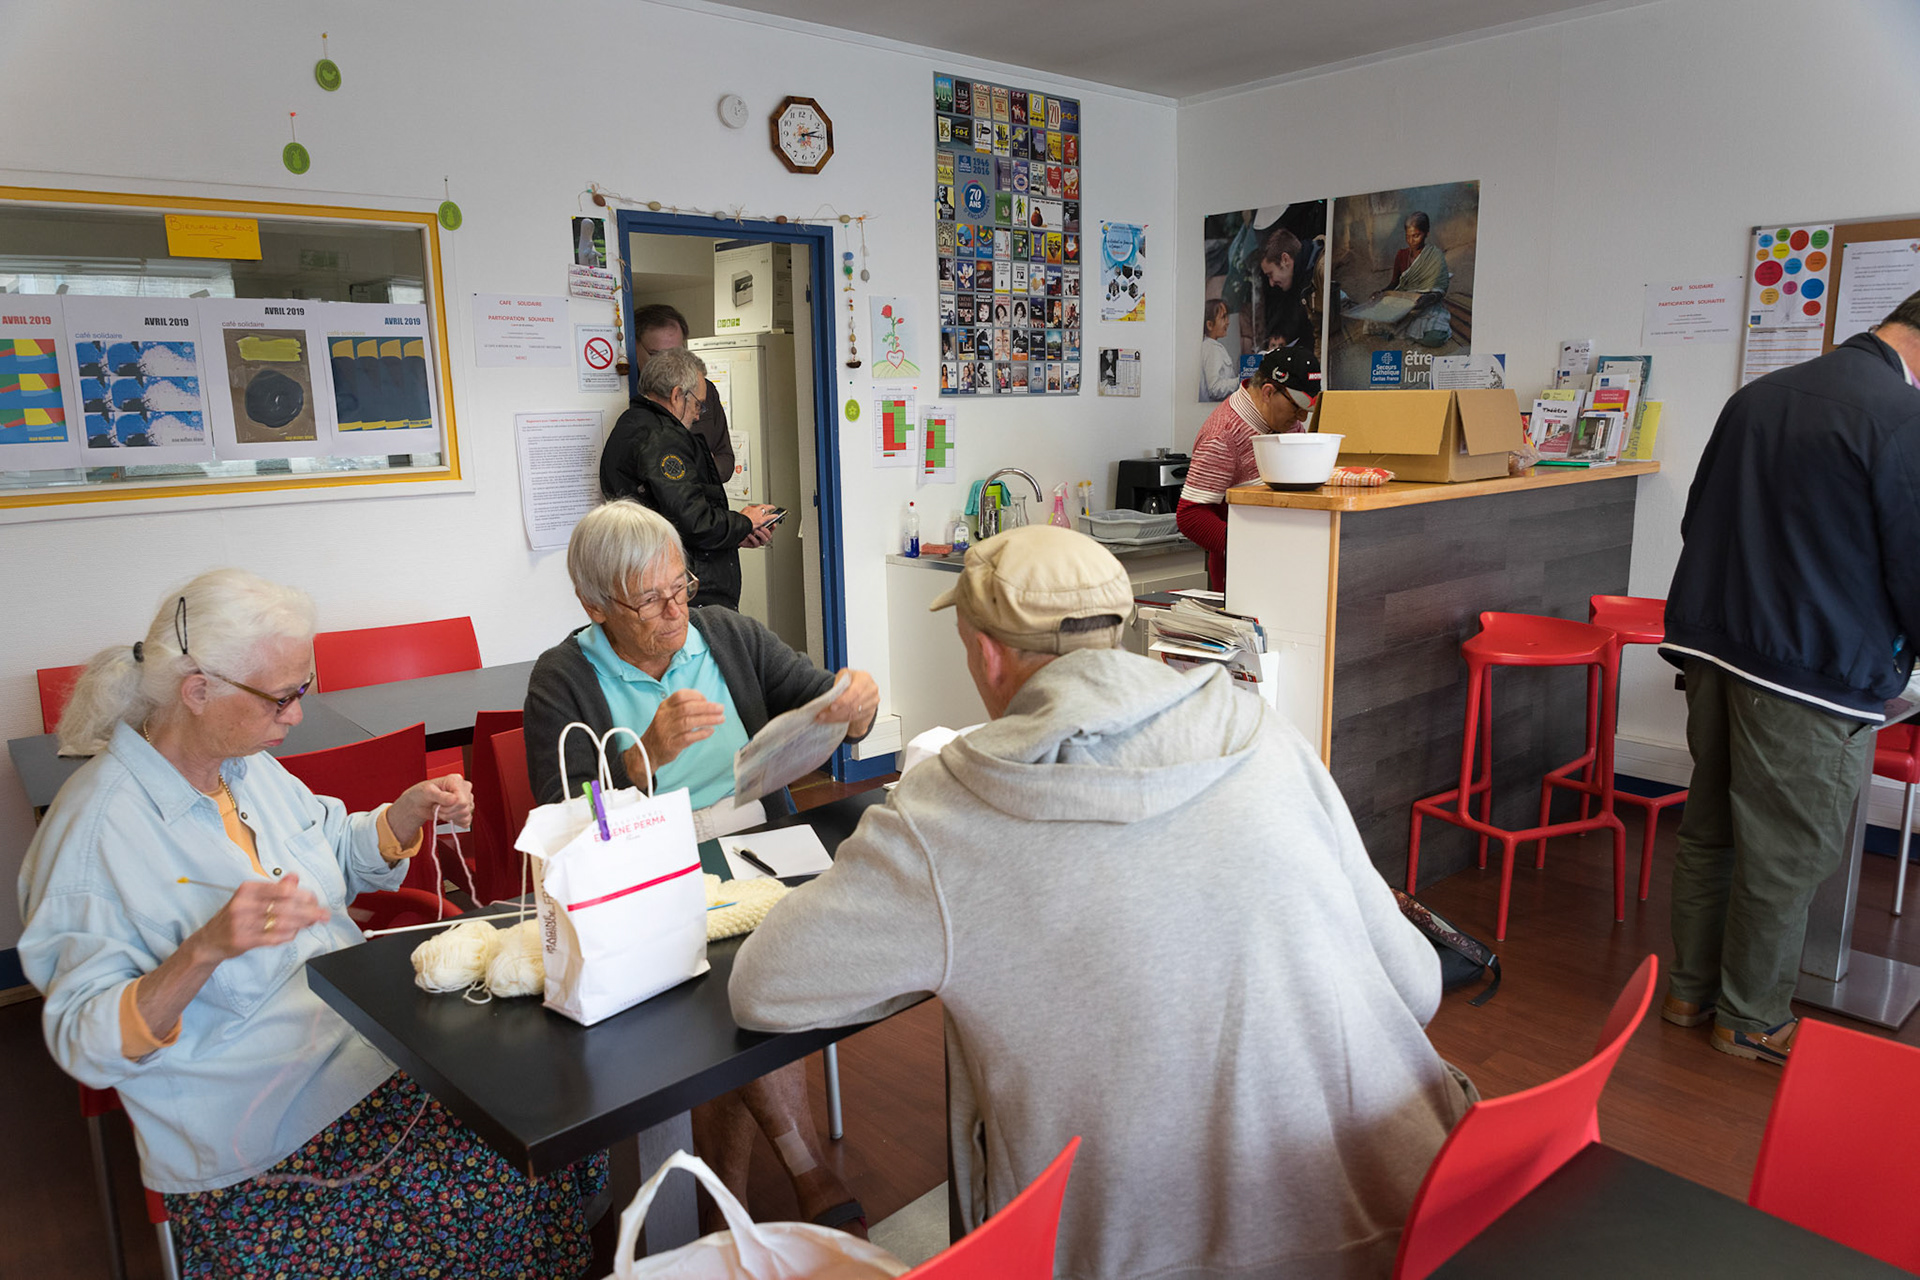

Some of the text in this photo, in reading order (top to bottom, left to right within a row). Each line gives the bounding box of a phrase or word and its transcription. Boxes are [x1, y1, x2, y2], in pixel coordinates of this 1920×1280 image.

[969, 188, 982, 201] 70
[969, 200, 981, 208] ANS
[264, 307, 305, 316] AVRIL 2019
[2, 315, 52, 325] AVRIL 2019
[144, 317, 189, 327] AVRIL 2019
[221, 320, 265, 328] café solidaire
[384, 317, 421, 326] AVRIL 2019
[75, 331, 123, 339] café solidaire
[1404, 350, 1433, 366] être
[634, 815, 666, 830] PERMA
